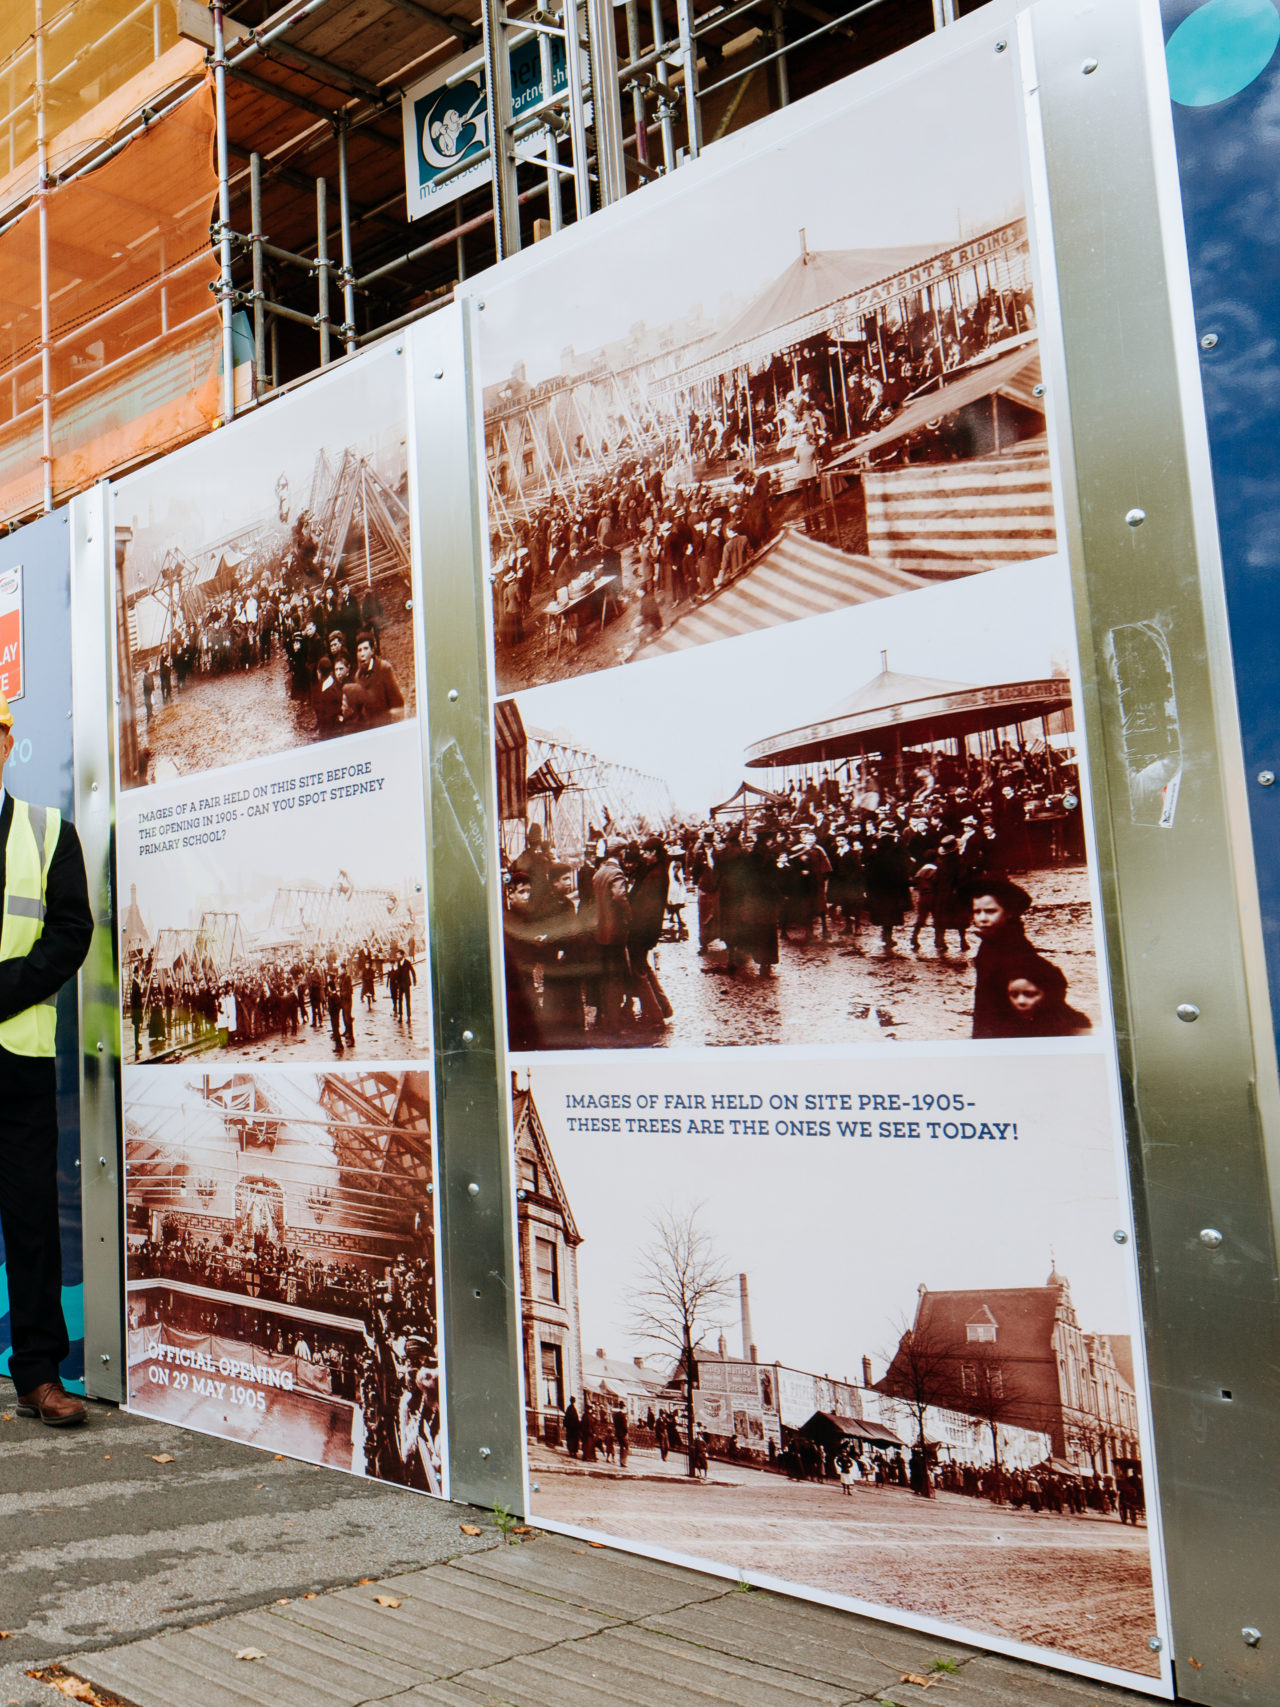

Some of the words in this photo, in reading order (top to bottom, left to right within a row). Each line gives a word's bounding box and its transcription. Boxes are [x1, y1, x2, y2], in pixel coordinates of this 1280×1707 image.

[959, 230, 1009, 264] RIDING
[138, 807, 174, 824] IMAGES
[175, 803, 188, 816] OF
[189, 802, 197, 813] A
[198, 796, 221, 812] FAIR
[223, 789, 251, 806] HELD
[252, 786, 268, 798] ON
[270, 779, 296, 795] THIS
[298, 773, 324, 789] SITE
[326, 761, 372, 782] BEFORE
[138, 827, 157, 840] THE
[158, 818, 201, 836] OPENING
[202, 815, 214, 827] IN
[215, 810, 238, 824] 1905
[246, 803, 270, 818] CAN
[271, 797, 296, 812] YOU
[297, 791, 328, 808] SPOT
[330, 778, 385, 801] STEPNEY
[138, 838, 180, 856] PRIMARY
[182, 829, 227, 849] SCHOOL?
[565, 1094, 632, 1109] IMAGES
[636, 1095, 659, 1110] OF
[664, 1095, 707, 1110] FAIR
[711, 1095, 764, 1111] HELD
[769, 1095, 799, 1111] ON
[804, 1095, 852, 1111] SITE
[566, 1117, 622, 1133] THESE
[625, 1119, 682, 1134] TREES
[686, 1119, 724, 1135] ARE
[729, 1120, 770, 1136] THE
[774, 1121, 831, 1138] ONES
[836, 1121, 873, 1138] WE
[878, 1121, 921, 1139] SEE
[926, 1122, 1019, 1140] TODAY!
[148, 1341, 217, 1374] OFFICIAL
[219, 1358, 294, 1391] OPENING
[149, 1365, 171, 1385] ON
[173, 1370, 190, 1389] 29
[191, 1376, 227, 1400] MAY
[229, 1385, 266, 1411] 1905
